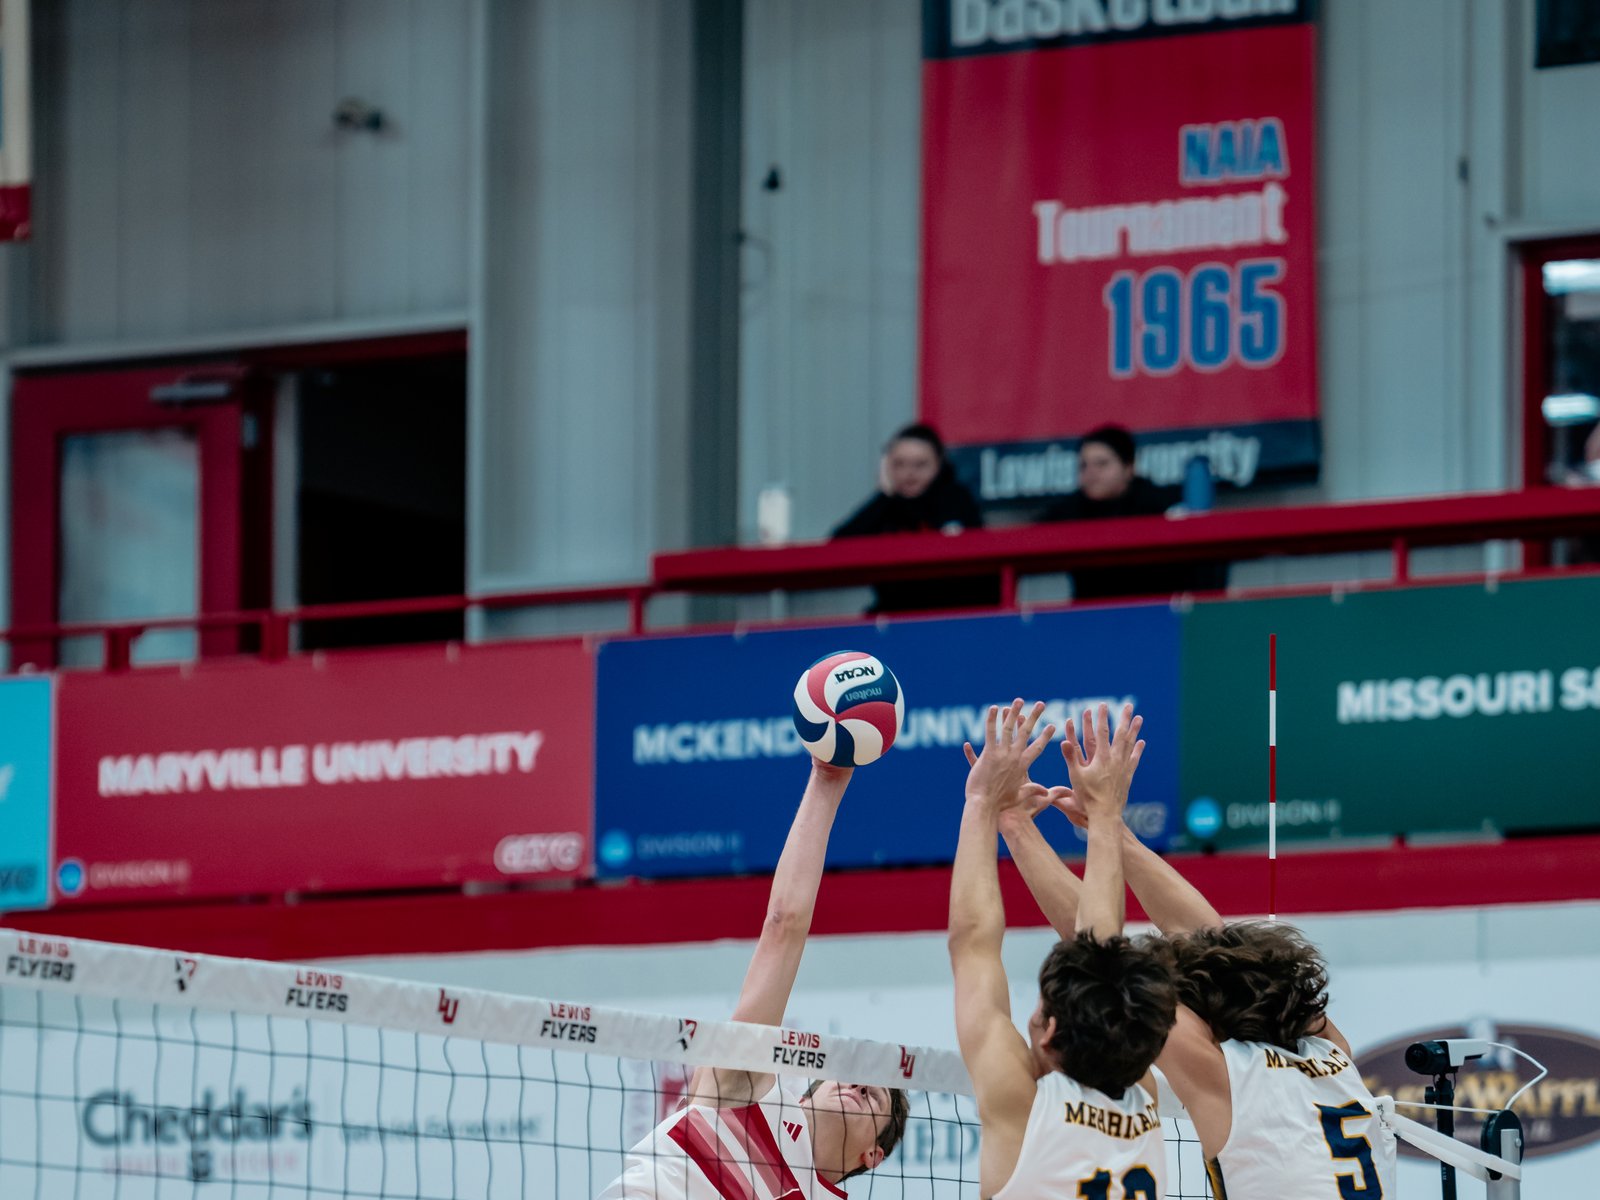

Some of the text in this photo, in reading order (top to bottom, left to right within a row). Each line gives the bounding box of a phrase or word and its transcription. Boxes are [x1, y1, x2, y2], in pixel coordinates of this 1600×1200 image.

[1180, 117, 1288, 186] NAIA
[1033, 182, 1289, 264] Tournament
[1103, 257, 1287, 379] 1965
[835, 665, 876, 684] NCAA
[844, 687, 883, 702] molten
[1337, 669, 1553, 724] MISSOURI
[632, 714, 800, 766] MCKEND
[98, 730, 544, 797] MARYVILLE UNIVERSITY
[18, 938, 70, 959] LEWIS
[7, 953, 76, 982] FLYERS
[295, 970, 344, 990] LEWIS
[286, 988, 348, 1013] FLYERS
[550, 1002, 592, 1021] LEWIS
[540, 1020, 597, 1044] FLYERS
[781, 1030, 820, 1049] LEWIS
[773, 1047, 826, 1070] FLYERS
